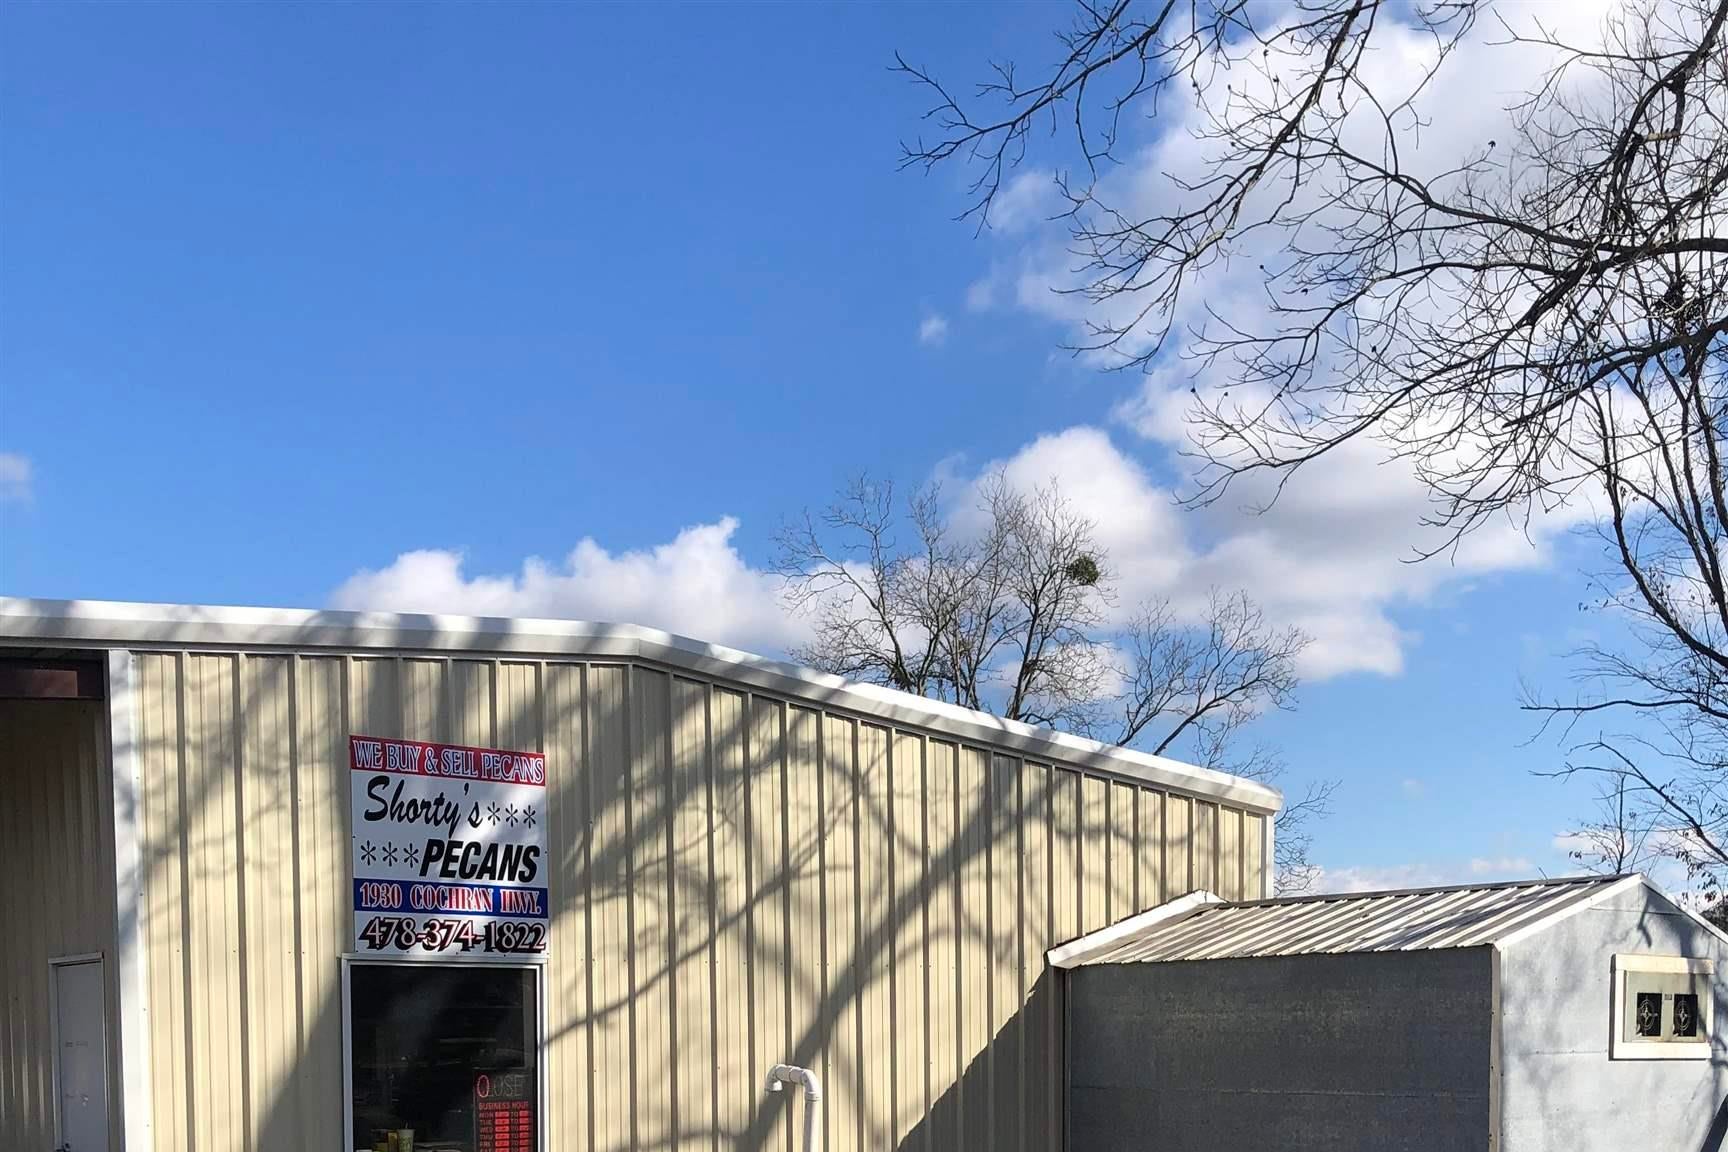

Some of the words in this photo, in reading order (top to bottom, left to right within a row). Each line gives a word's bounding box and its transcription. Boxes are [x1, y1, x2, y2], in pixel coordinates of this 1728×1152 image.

[352, 739, 384, 770] WE
[386, 743, 421, 772] BUY
[425, 748, 438, 772] &
[441, 751, 478, 777] SELL
[481, 754, 545, 784] PECANS
[419, 839, 541, 883] PECANS
[360, 881, 402, 908] 1930
[410, 883, 493, 912] COCHRAN
[500, 889, 542, 914] HWY.
[359, 916, 546, 953] 478-374-1822
